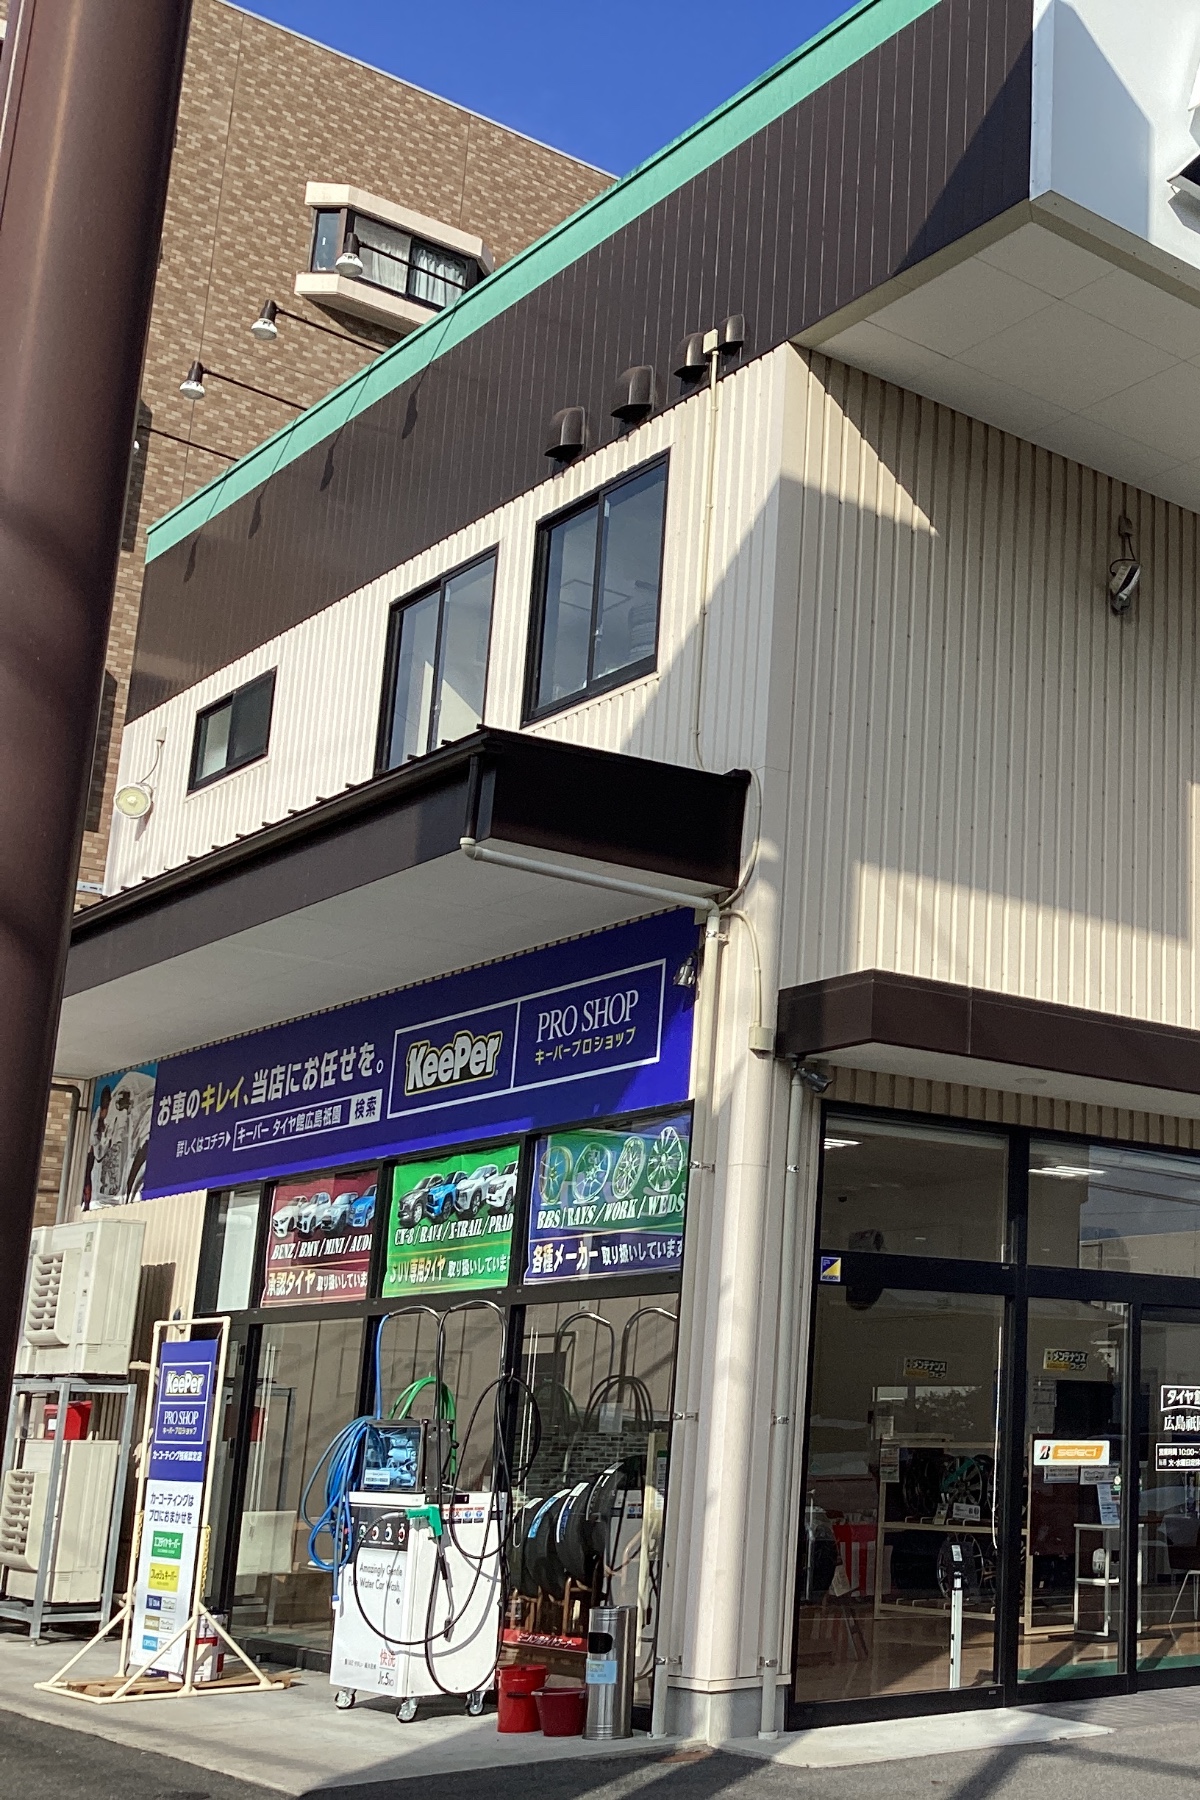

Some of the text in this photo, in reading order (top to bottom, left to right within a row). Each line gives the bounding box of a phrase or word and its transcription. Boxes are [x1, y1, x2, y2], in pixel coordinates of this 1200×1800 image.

[536, 989, 639, 1043] PRO SHOP
[534, 1026, 637, 1065] キーパープロショップ
[405, 1031, 502, 1094] KeePer
[157, 1041, 384, 1127] お車のキレイ、当店にお任せを。
[176, 1131, 226, 1158] 詳しくはコチラ
[237, 1122, 269, 1144] キーパー
[354, 1096, 377, 1120] 検索
[532, 1241, 598, 1273] 各種メーカー
[165, 1371, 205, 1396] KeePer
[163, 1410, 199, 1425] PRO SHOP
[151, 1492, 194, 1507] カーコーティングは
[149, 1509, 193, 1525] プロにおまかせを
[360, 1562, 385, 1578] Amazingly
[360, 1577, 374, 1589] Water
[376, 1579, 385, 1590] Car
